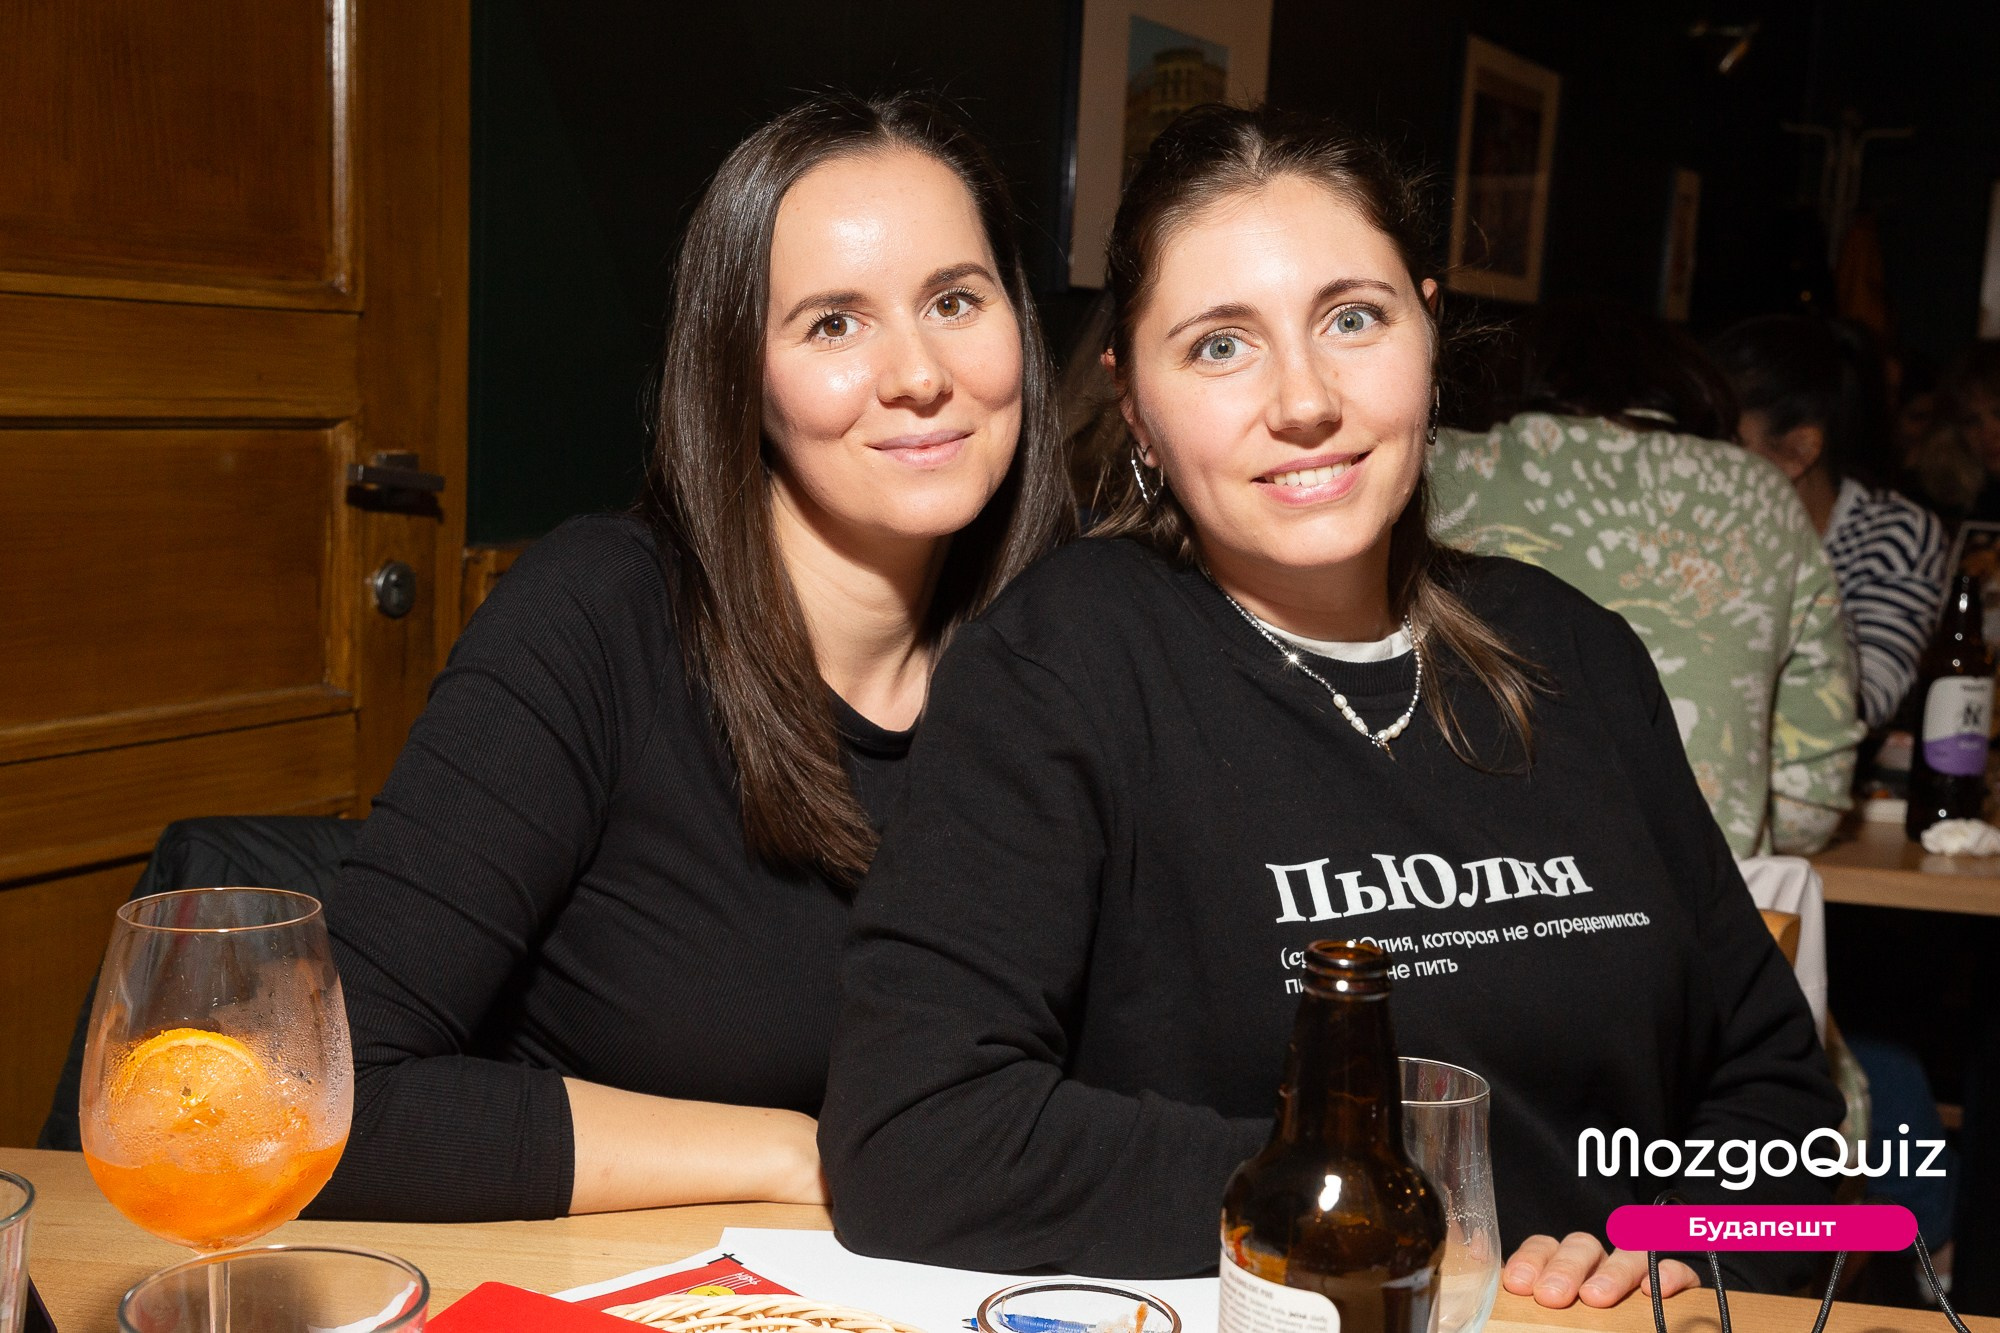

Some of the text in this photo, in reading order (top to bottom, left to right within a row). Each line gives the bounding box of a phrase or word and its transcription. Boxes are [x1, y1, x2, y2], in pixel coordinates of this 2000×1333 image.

[1265, 853, 1593, 923] ПьЮлия
[1422, 929, 1499, 949] которая
[1503, 925, 1528, 942] не
[1534, 911, 1650, 938] определилась
[1415, 958, 1458, 977] пить
